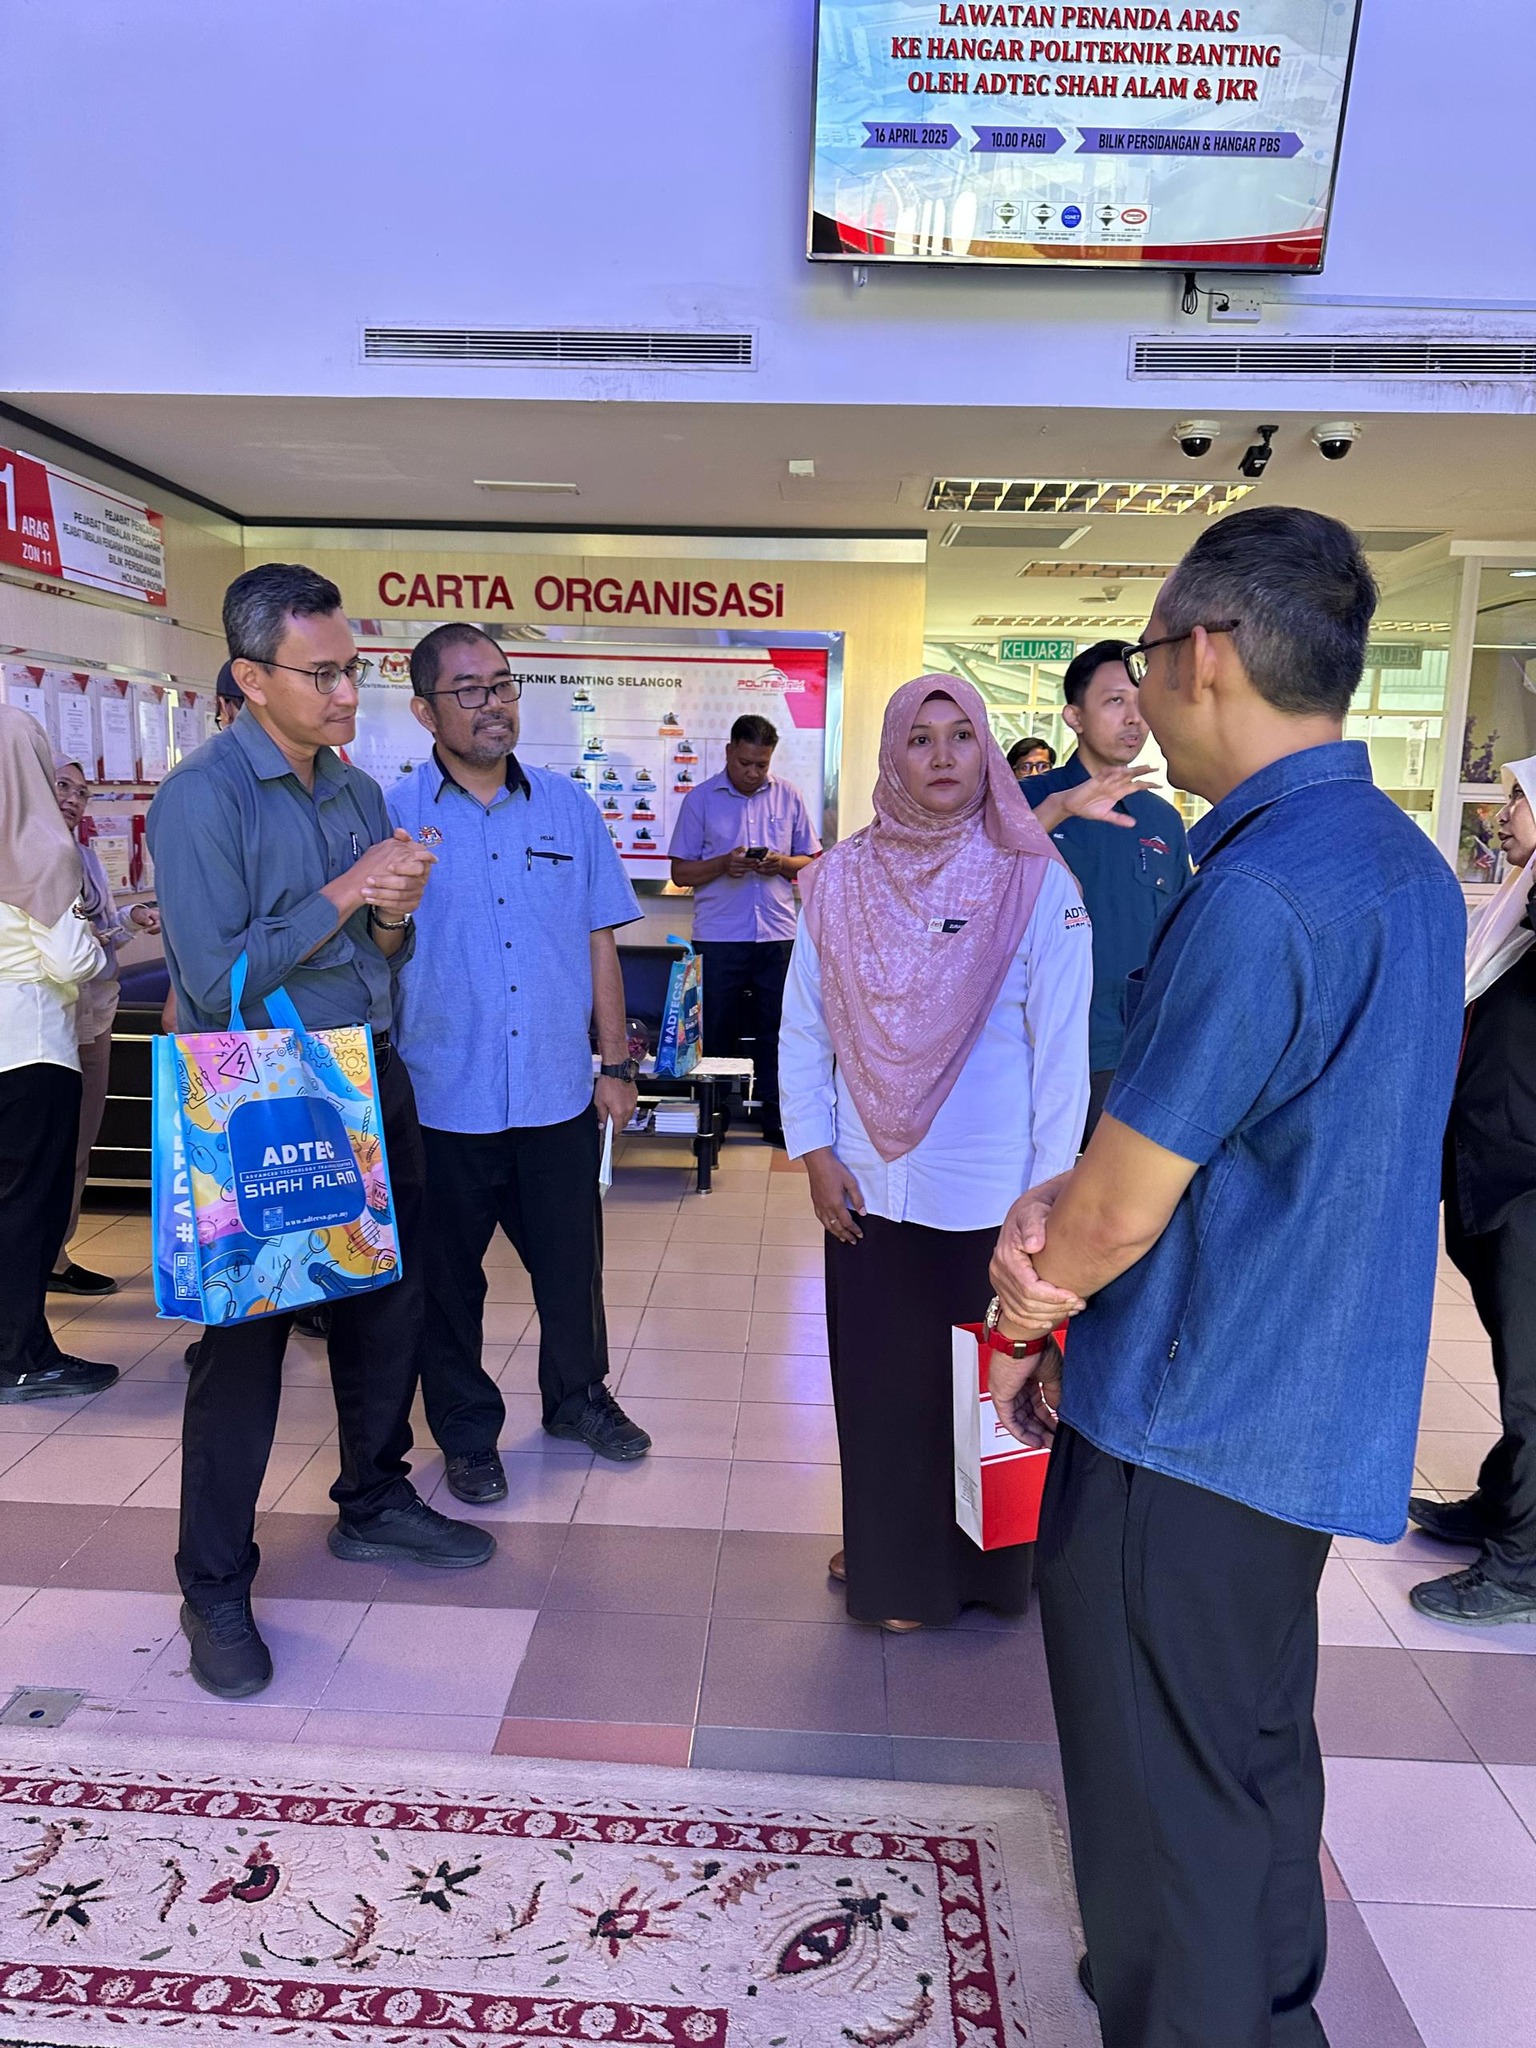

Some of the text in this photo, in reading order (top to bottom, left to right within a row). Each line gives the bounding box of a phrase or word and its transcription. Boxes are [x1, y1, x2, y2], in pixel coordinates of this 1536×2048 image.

[939, 3, 1240, 33] LAWATAN PENANDA ARAS
[891, 37, 1281, 68] KE HANGAR POLITEKNIK BANTING
[908, 71, 1258, 105] OLEH ADTEC SHAH ALAM & JKR
[875, 128, 948, 144] 16 APRIL 2025
[991, 132, 1046, 148] 10.00 PAGI
[1099, 133, 1281, 153] BILIK PERSIDANGAN & HANGAR PBS
[22, 515, 50, 542] ARAS
[74, 511, 101, 530] PEJABAT
[105, 509, 130, 527] PEJABAT
[22, 543, 52, 566] ZON 11
[378, 571, 783, 618] CARTA ORGANISASI
[1003, 641, 1058, 659] KELUAR
[513, 673, 682, 688] TEKNIK BANTING SELANGOR
[664, 973, 685, 1044] #ADTECSA
[262, 1141, 335, 1167] ADTEC
[244, 1170, 357, 1199] SHAH ALAM
[245, 1171, 279, 1180] ADVANCED
[279, 1166, 317, 1175] TECHNOLOGY
